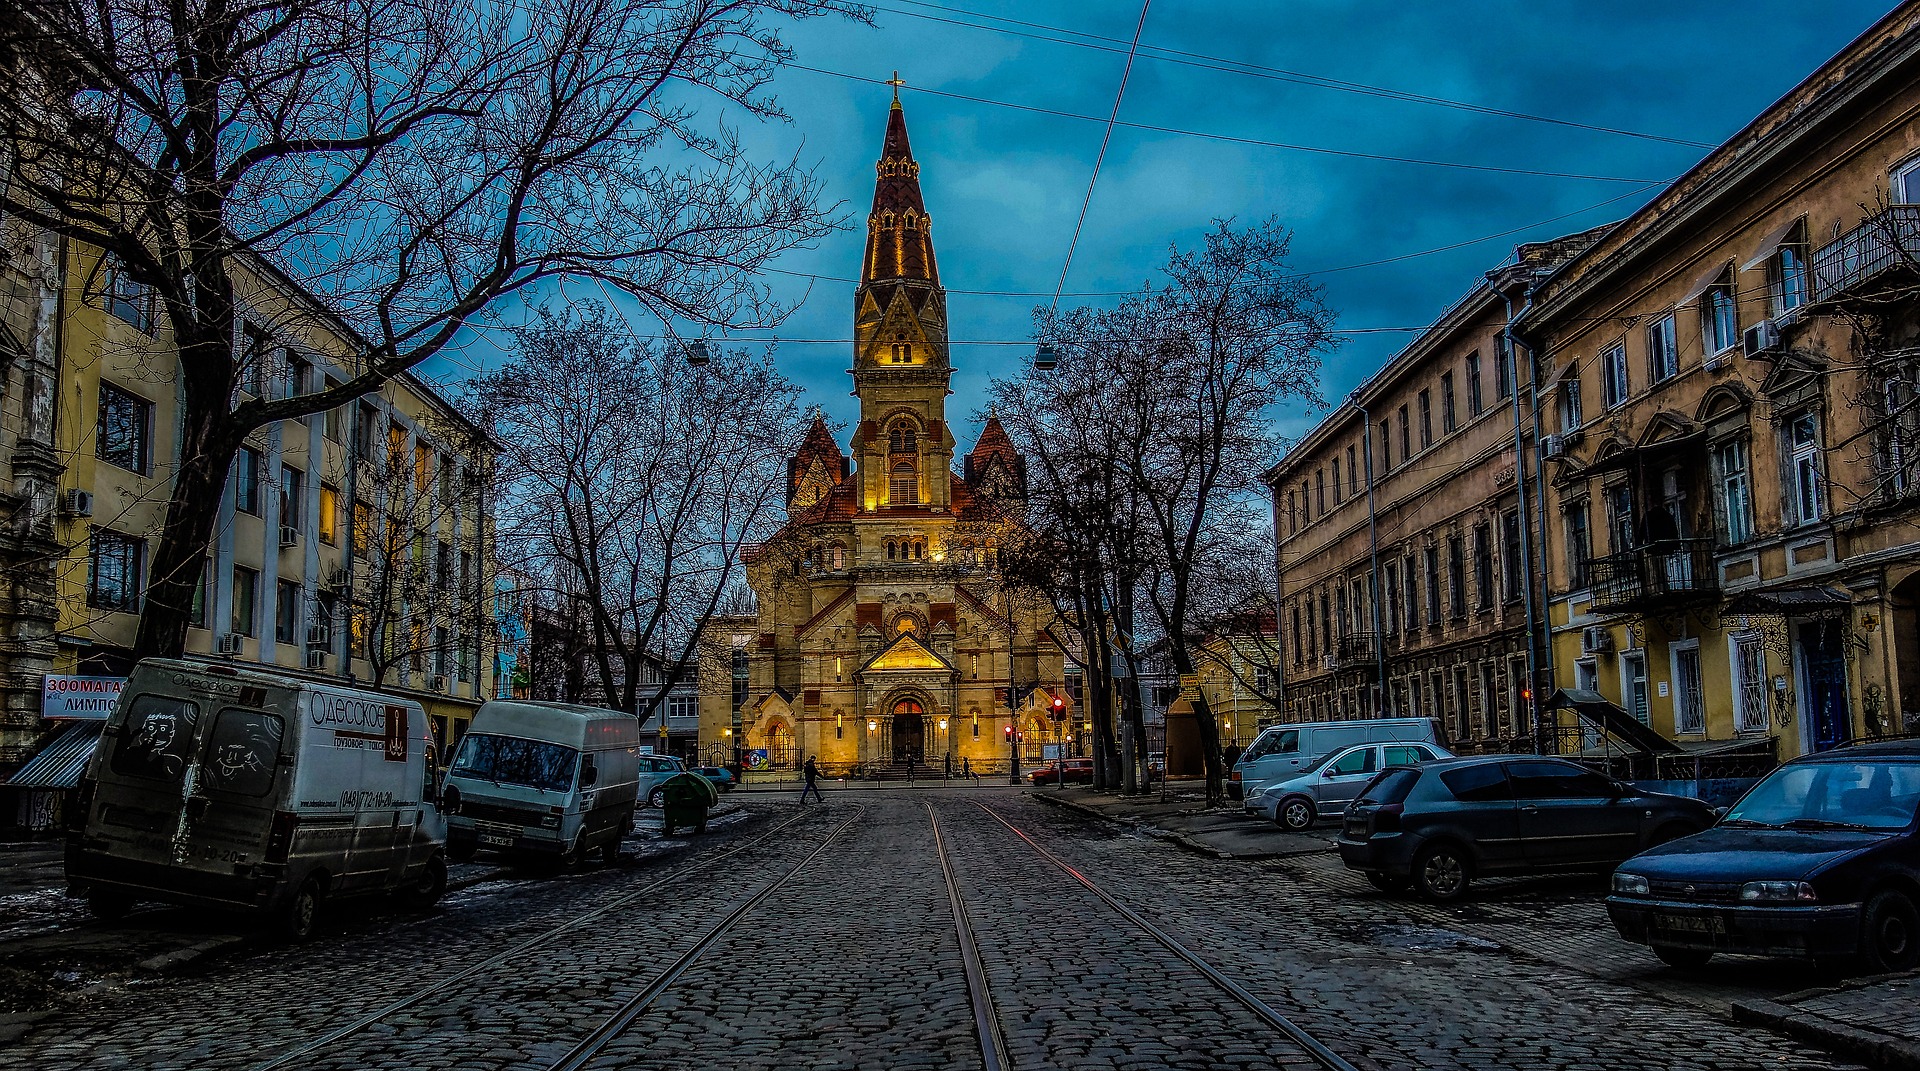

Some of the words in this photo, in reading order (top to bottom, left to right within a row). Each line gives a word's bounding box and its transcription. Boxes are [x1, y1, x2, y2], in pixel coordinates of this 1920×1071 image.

[48, 679, 127, 693] ЗООМАГА
[173, 674, 240, 694] Одесское
[311, 690, 385, 729] Одесское
